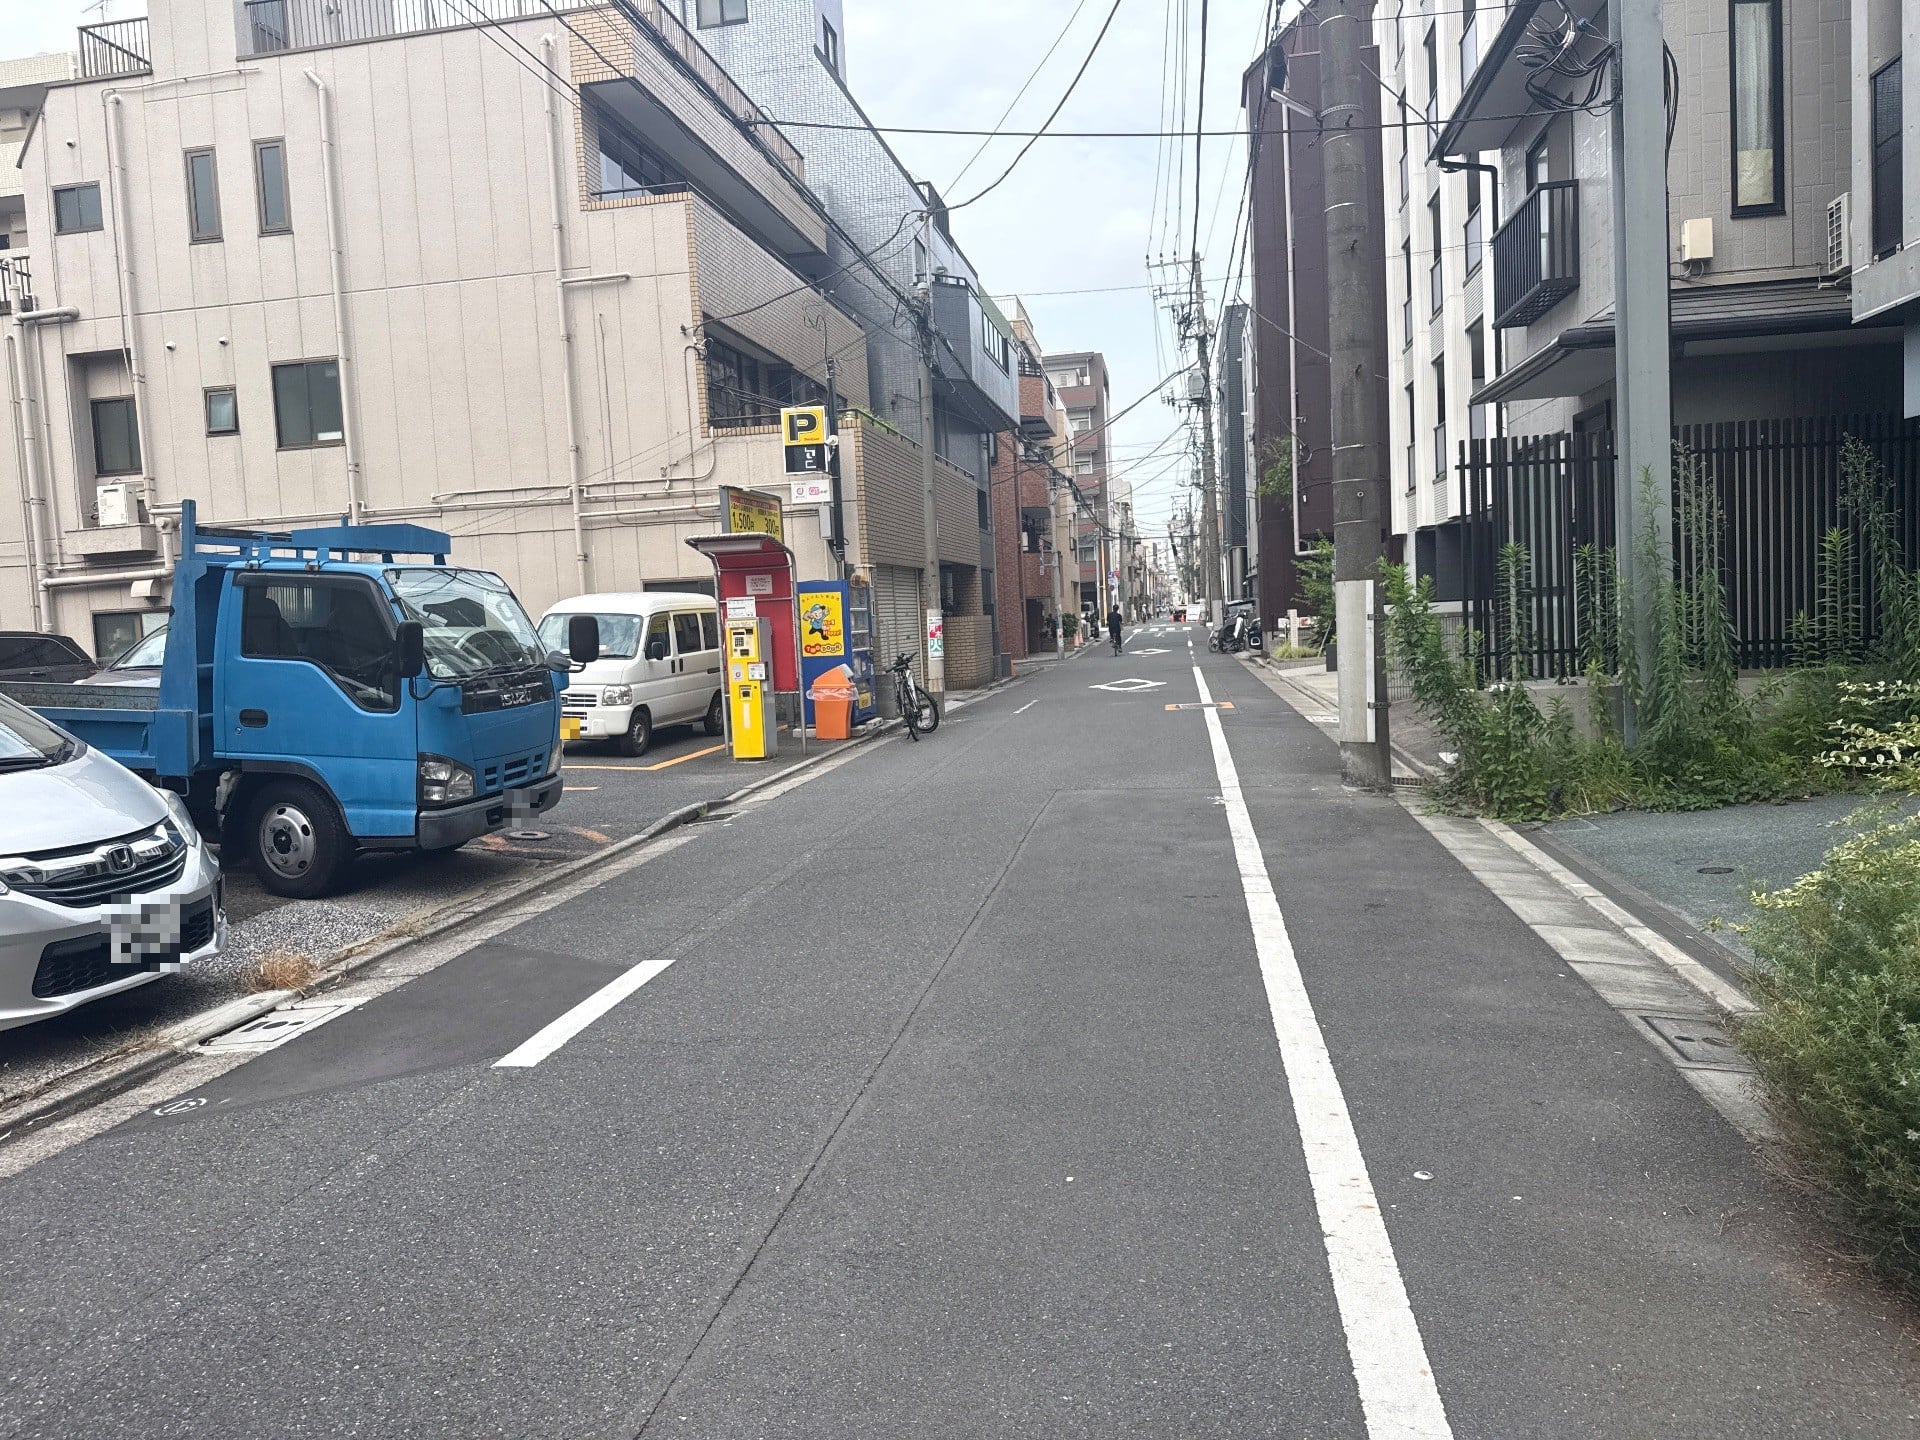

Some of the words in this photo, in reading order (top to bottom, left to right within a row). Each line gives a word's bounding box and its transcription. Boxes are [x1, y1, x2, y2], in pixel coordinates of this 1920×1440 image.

[788, 413, 817, 441] P
[930, 639, 941, 651] 火
[500, 690, 532, 706] ISUZU
